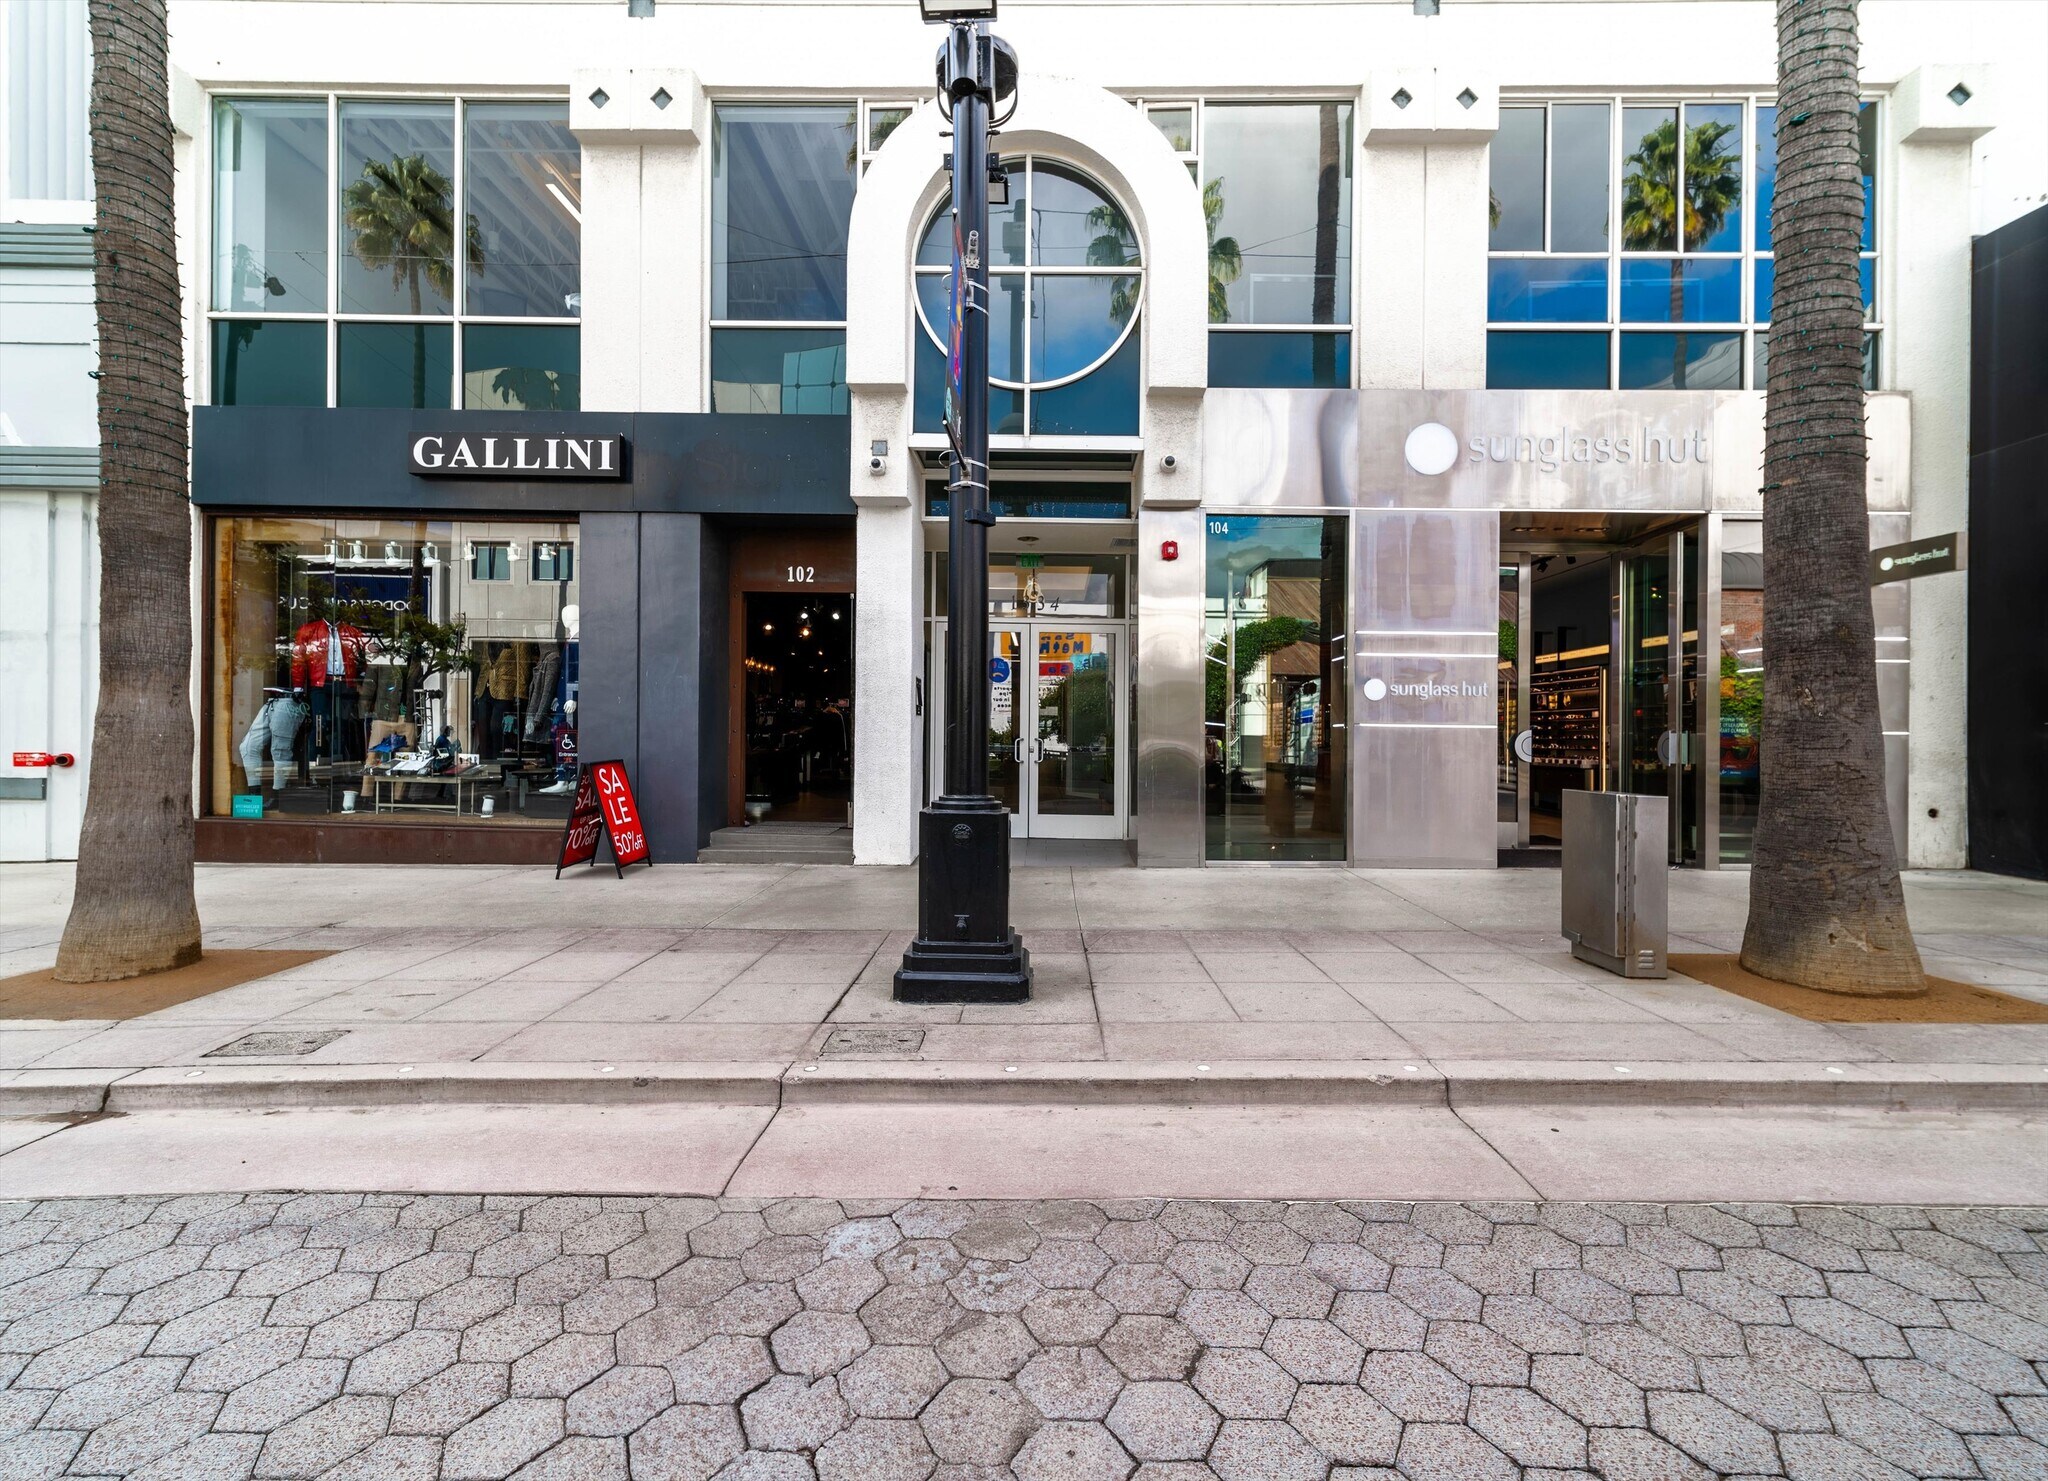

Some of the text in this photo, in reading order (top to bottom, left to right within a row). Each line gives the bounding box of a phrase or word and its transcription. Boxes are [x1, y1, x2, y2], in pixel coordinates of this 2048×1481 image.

[412, 436, 614, 470] GALLINI
[1468, 426, 1708, 473] sunglass hut
[1209, 521, 1229, 534] 104
[787, 566, 814, 583] 102
[1390, 680, 1488, 700] sunglass hut
[599, 767, 625, 794] SA
[609, 797, 632, 825] LE
